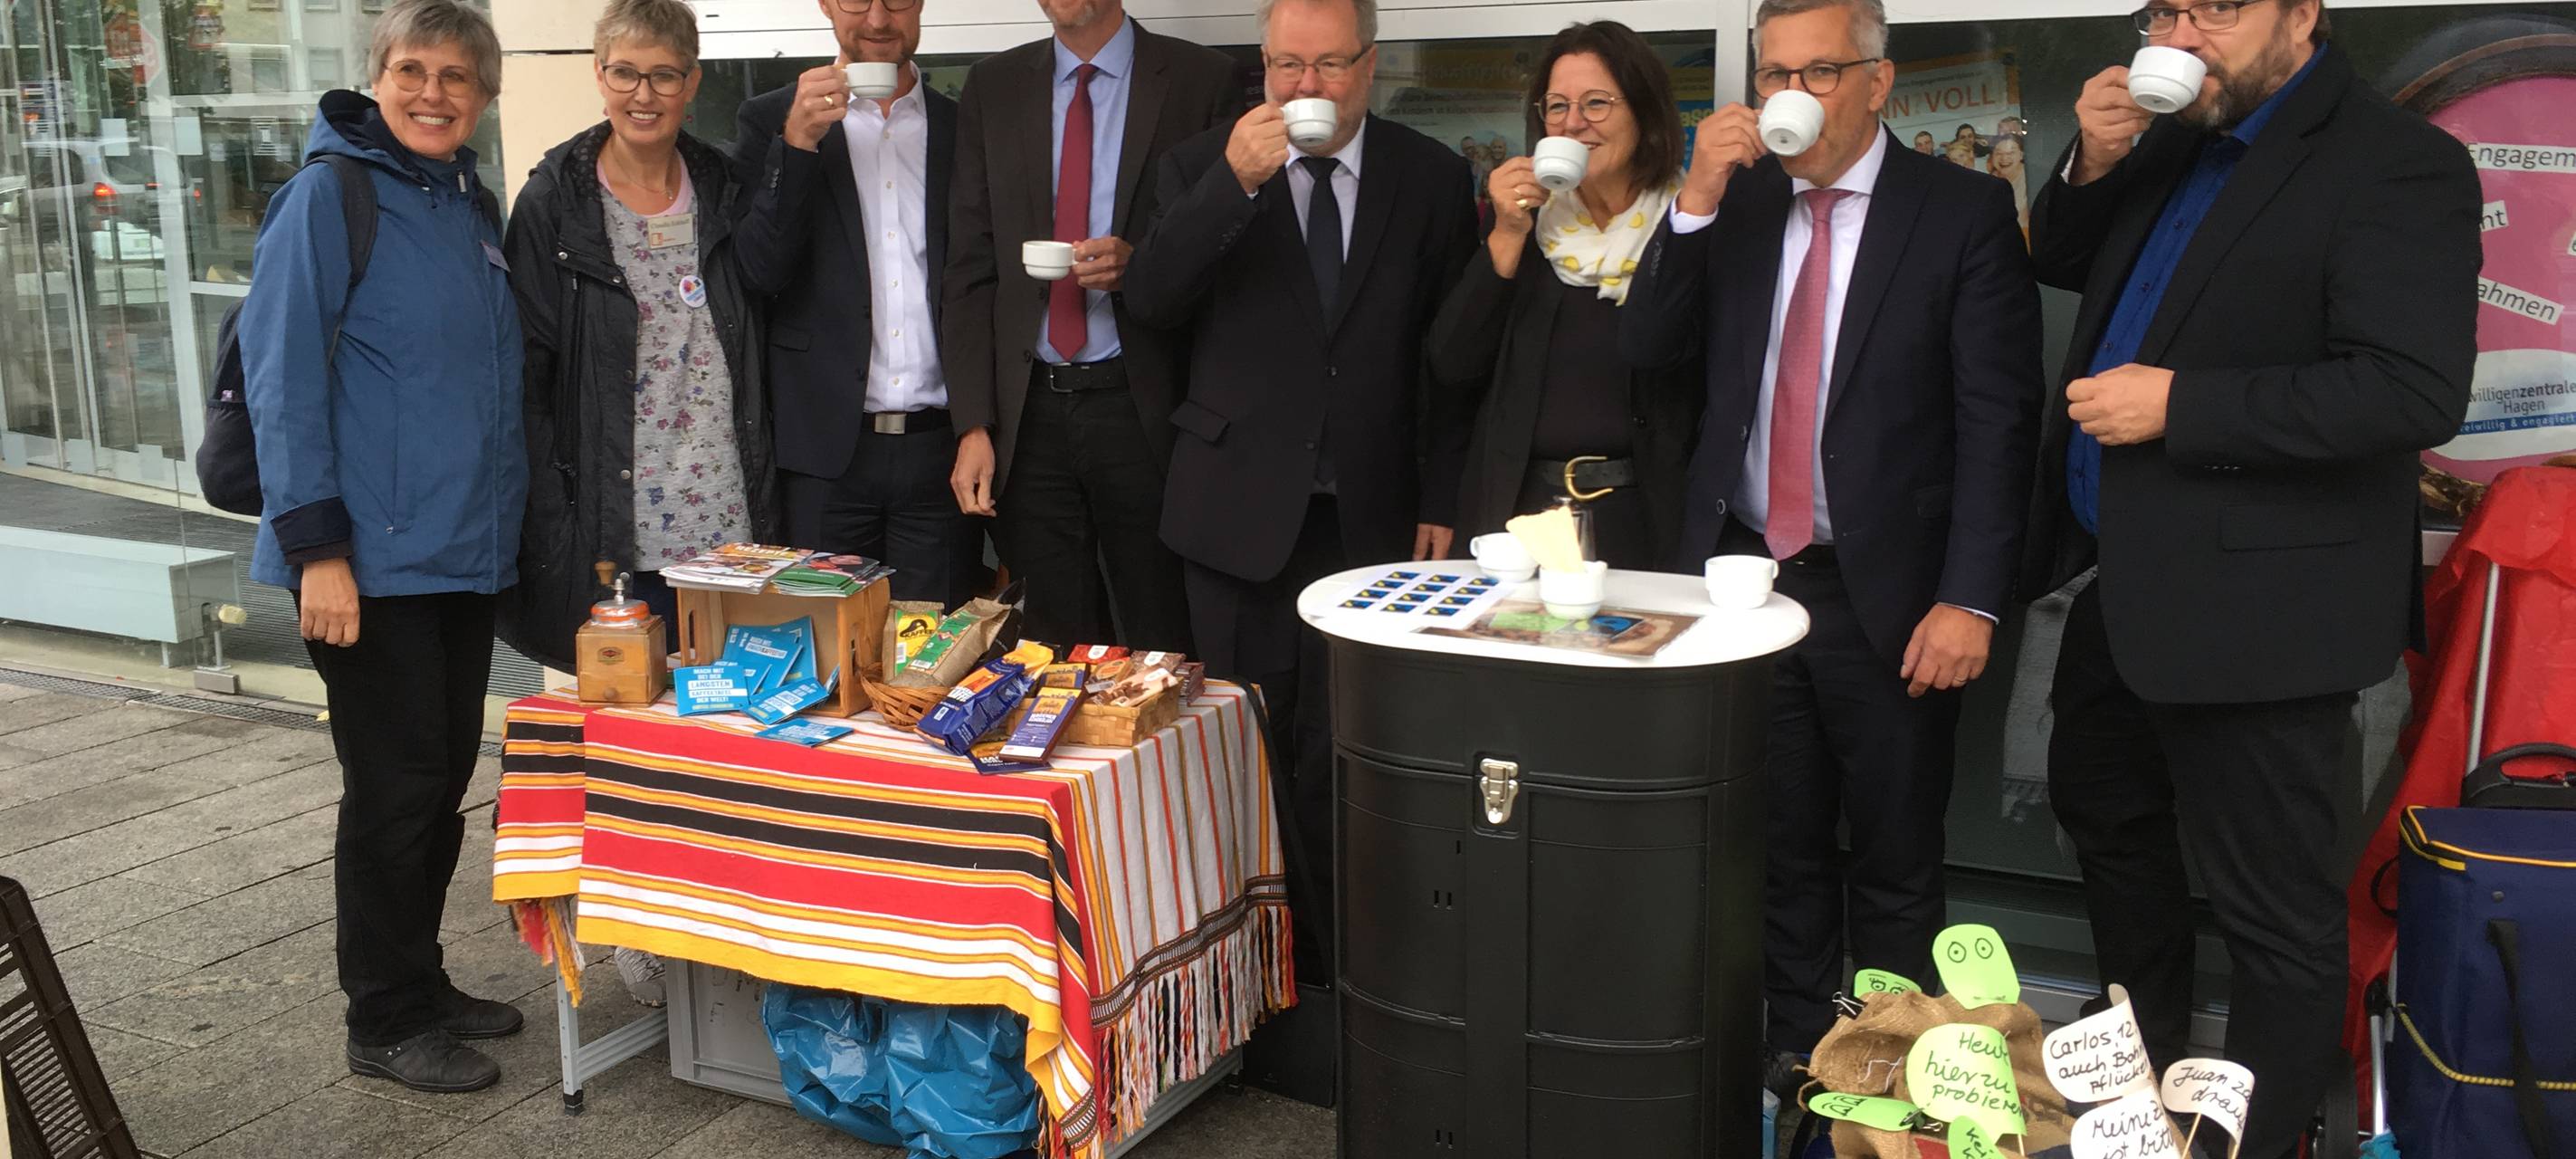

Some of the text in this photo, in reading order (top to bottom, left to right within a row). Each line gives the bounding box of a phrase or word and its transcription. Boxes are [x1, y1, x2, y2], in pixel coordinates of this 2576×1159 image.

[1924, 84, 1995, 112] VOLL
[2504, 399, 2545, 415] Hagen
[2523, 413, 2573, 427] engagiert
[1925, 1050, 2011, 1094] hier zu
[2059, 1055, 2105, 1078] auch
[2173, 1067, 2228, 1087] Juan
